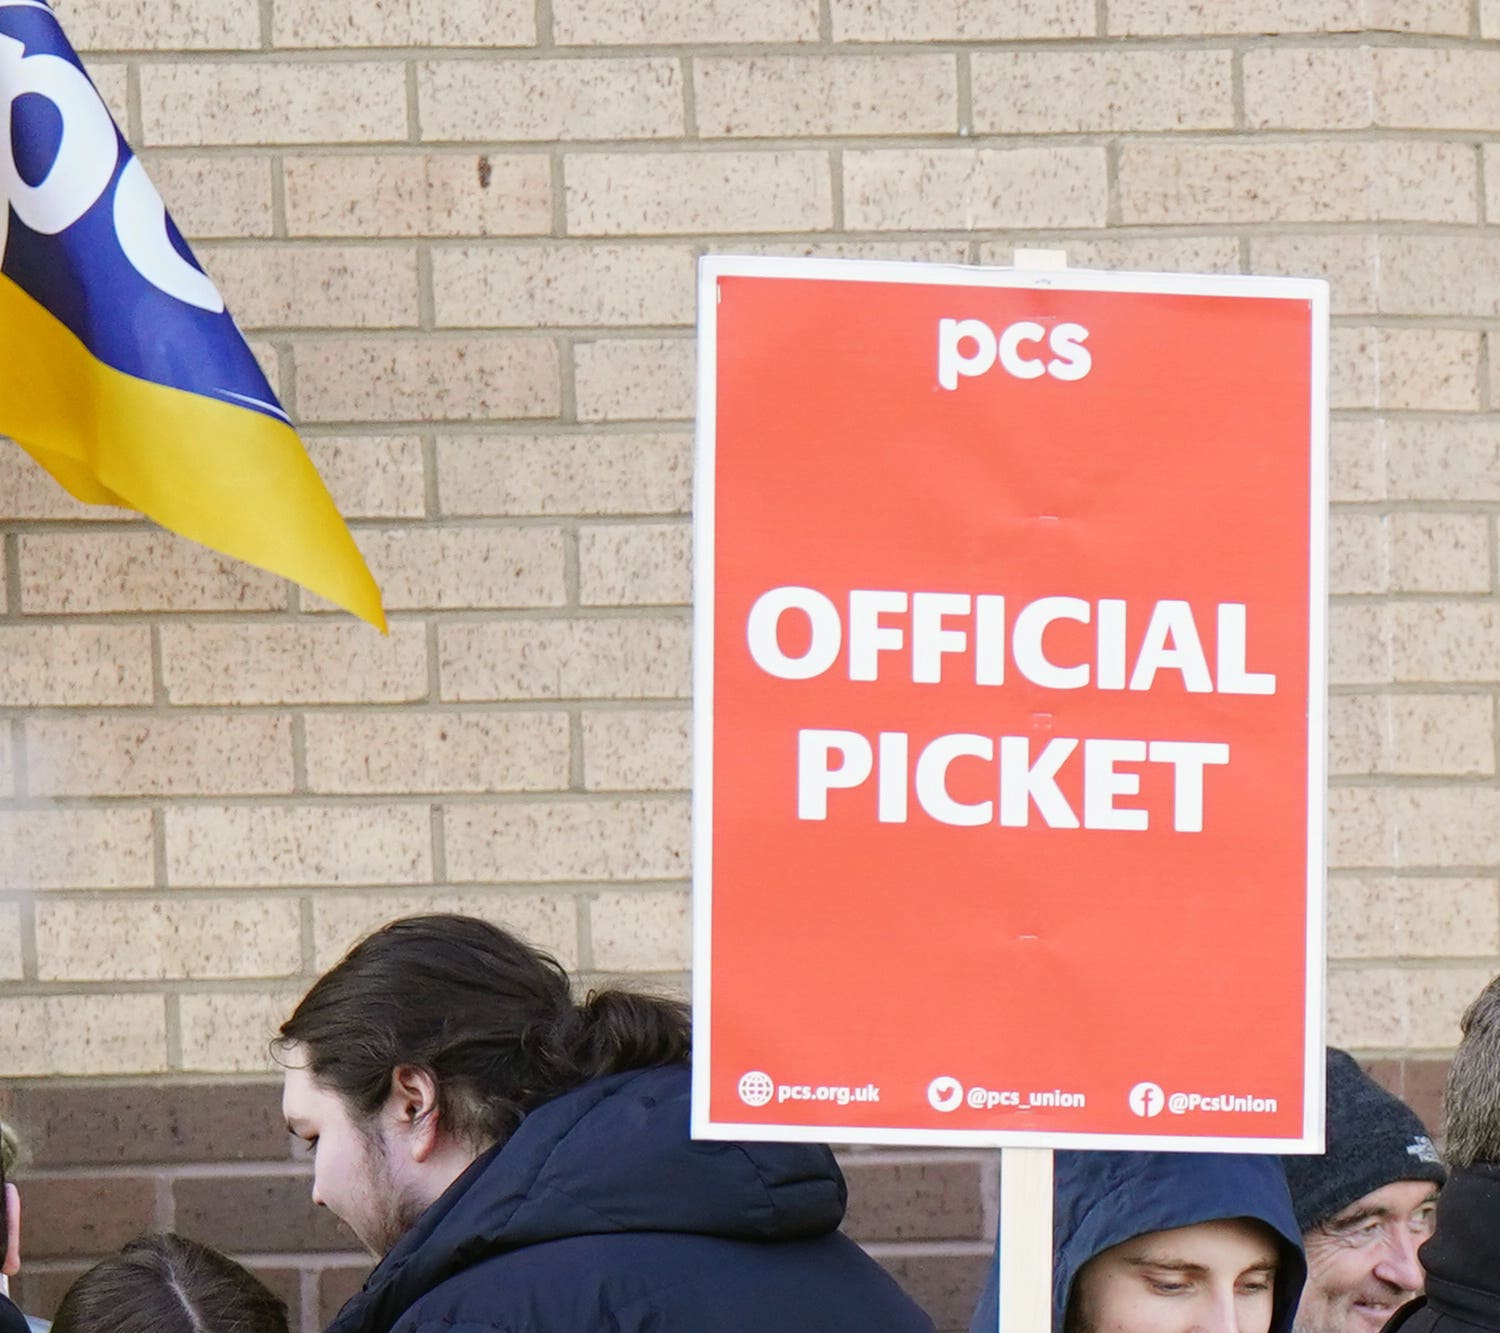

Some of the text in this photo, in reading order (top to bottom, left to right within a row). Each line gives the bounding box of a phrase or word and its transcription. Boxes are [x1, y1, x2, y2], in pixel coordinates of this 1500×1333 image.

[937, 317, 1092, 391] pcs
[746, 585, 1277, 696] OFFICIAL
[797, 728, 1230, 833] PICKET
[777, 1082, 1279, 1115] pcs.org.uk @pcs_union @PcsUnion
